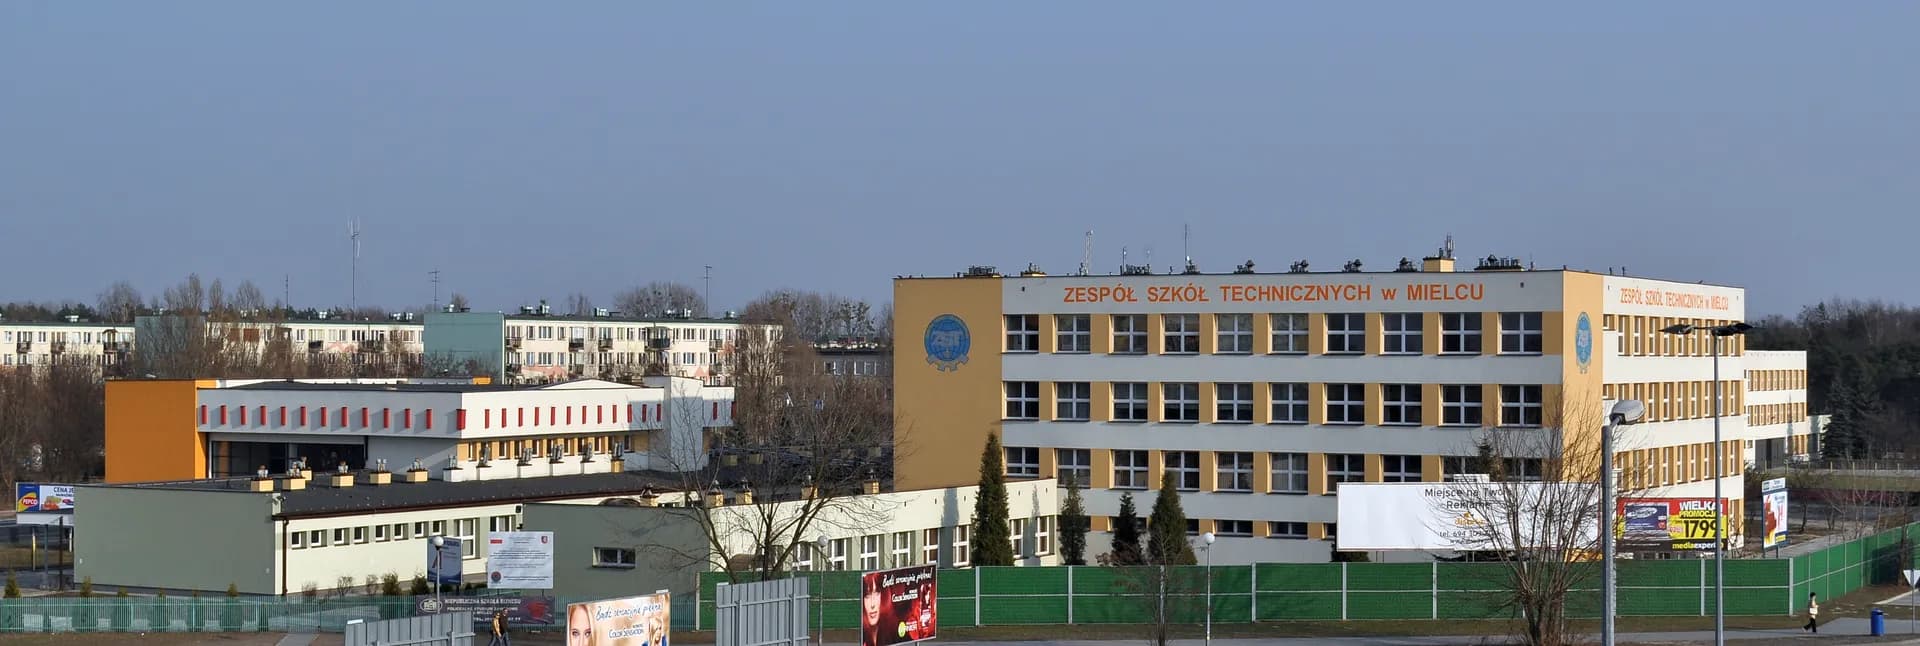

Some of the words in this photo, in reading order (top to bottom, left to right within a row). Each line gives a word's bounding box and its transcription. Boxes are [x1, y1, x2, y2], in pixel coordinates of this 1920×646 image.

[1063, 283, 1138, 303] ZESPÓŁ
[1147, 282, 1209, 302] SZKÓŁ
[1219, 284, 1371, 302] TECHNICZNYCH
[1381, 288, 1397, 300] w
[1407, 283, 1484, 301] MIELCU
